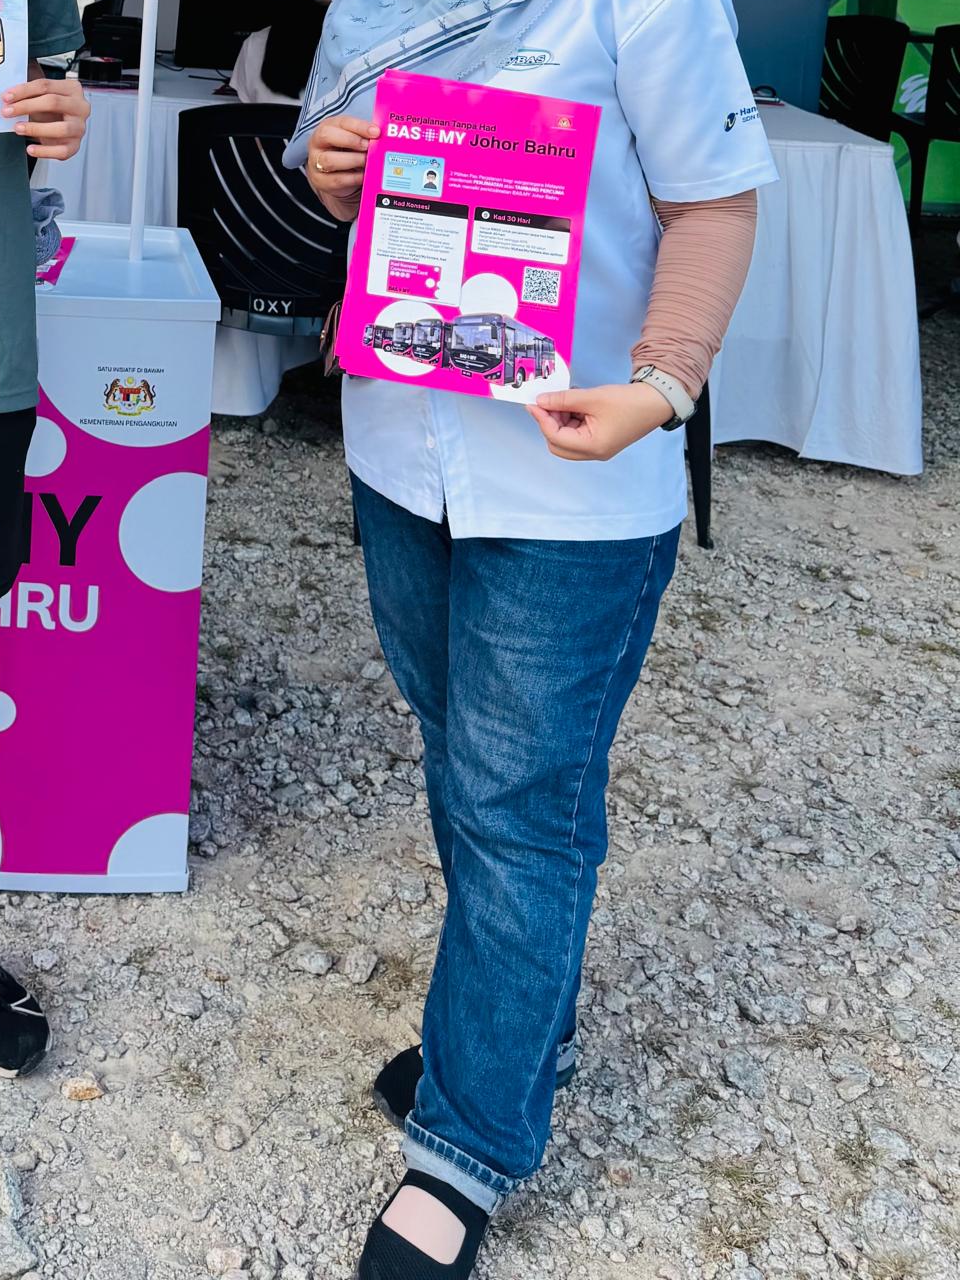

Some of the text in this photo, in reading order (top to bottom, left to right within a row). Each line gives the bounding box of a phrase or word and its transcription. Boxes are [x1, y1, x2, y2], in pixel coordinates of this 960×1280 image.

[390, 112, 496, 132] Pas Perjalanan Tanpa Had
[387, 123, 576, 158] BAS MY Johor Bahru
[393, 200, 405, 208] Kad
[493, 214, 506, 222] Kad
[518, 216, 531, 224] Hari
[253, 298, 292, 314] OXY
[80, 418, 178, 428] KEMENTERIAN PENGANGKUTAN
